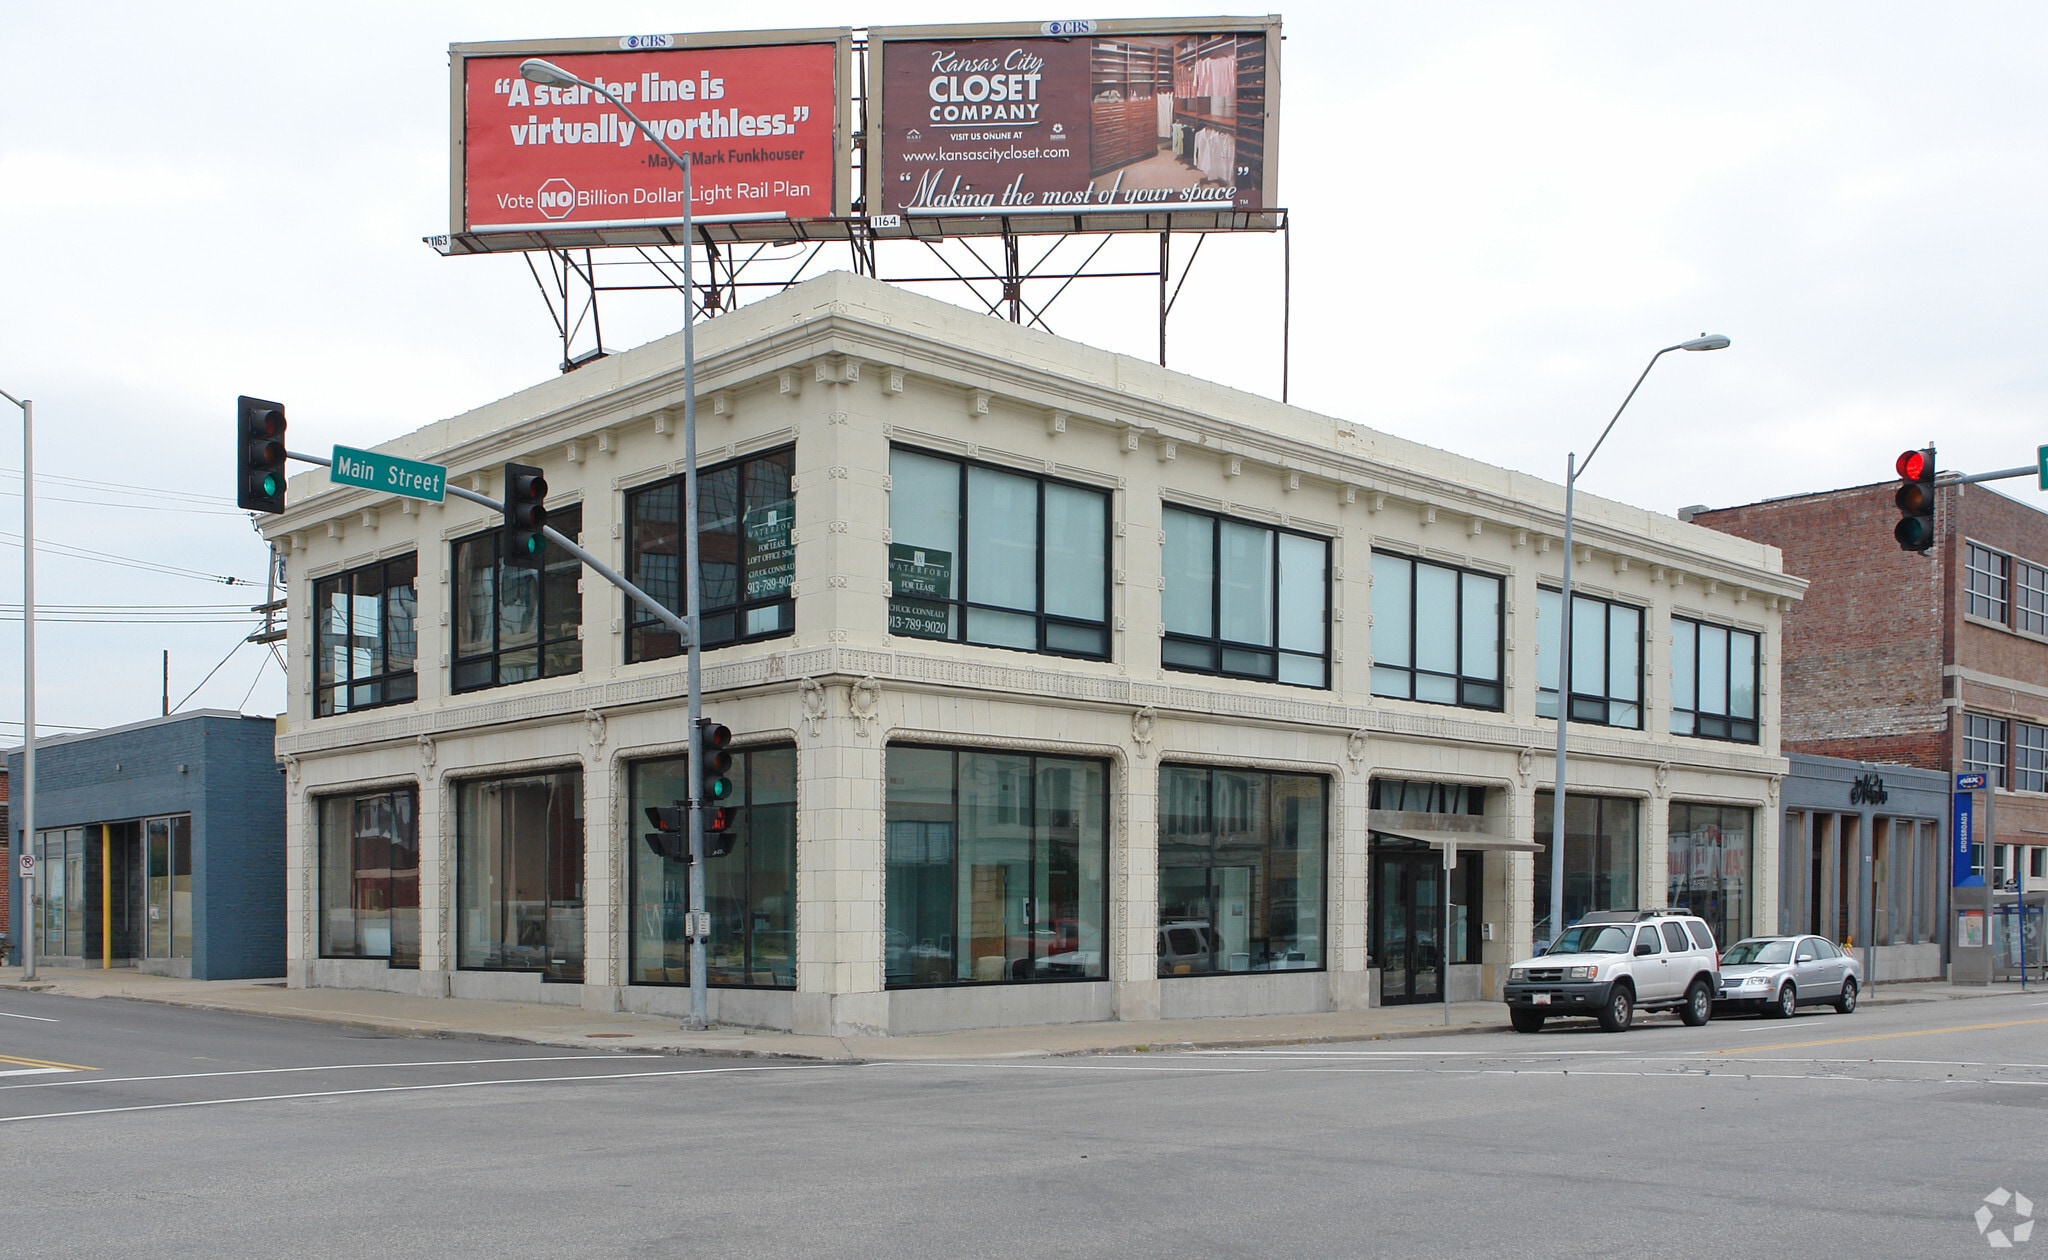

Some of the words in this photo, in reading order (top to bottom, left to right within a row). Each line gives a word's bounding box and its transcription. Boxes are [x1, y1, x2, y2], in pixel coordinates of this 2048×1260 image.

[1063, 20, 1089, 34] CBS
[641, 35, 666, 47] CBS
[931, 51, 1000, 74] Kansas
[1004, 49, 1045, 75] City
[534, 77, 637, 106] starter
[641, 72, 696, 103] line
[700, 70, 725, 100] is
[929, 74, 1042, 103] CLOSET
[930, 104, 1040, 121] COMPANY
[510, 113, 637, 147] virtually
[642, 106, 810, 142] worthless.”
[950, 133, 969, 141] VISIT
[970, 132, 981, 141] US
[983, 131, 1012, 140] ONLINE
[1013, 131, 1023, 139] AT
[648, 153, 683, 171] May
[692, 151, 725, 166] Mark
[728, 148, 805, 164] Funkhouser
[903, 145, 1070, 163] www.kansascitycloset.com
[497, 193, 534, 209] Vote
[541, 191, 573, 208] NO
[577, 189, 628, 207] Billion
[634, 187, 684, 204] Dollar
[690, 184, 732, 205] Light
[737, 182, 768, 199] Rail
[773, 180, 810, 197] Plan
[1002, 173, 1034, 206] the
[1042, 181, 1095, 205] most
[1098, 170, 1124, 206] of
[1124, 186, 1173, 205] your
[874, 216, 897, 226] 1164
[431, 236, 448, 246] 1163
[338, 456, 374, 481] Main
[388, 465, 440, 492] Street
[758, 543, 769, 552] FOR
[770, 540, 786, 550] LEASE
[747, 555, 761, 565] LOFT
[762, 551, 780, 562] OFFICE
[748, 569, 767, 578] CHUCK
[889, 562, 949, 578] WATERFORD
[901, 580, 914, 590] FOR
[915, 582, 936, 592] LEASE
[889, 604, 911, 614] CHUCK
[912, 606, 946, 618] CONNEALY
[1960, 812, 1968, 853] CROSSROADS
